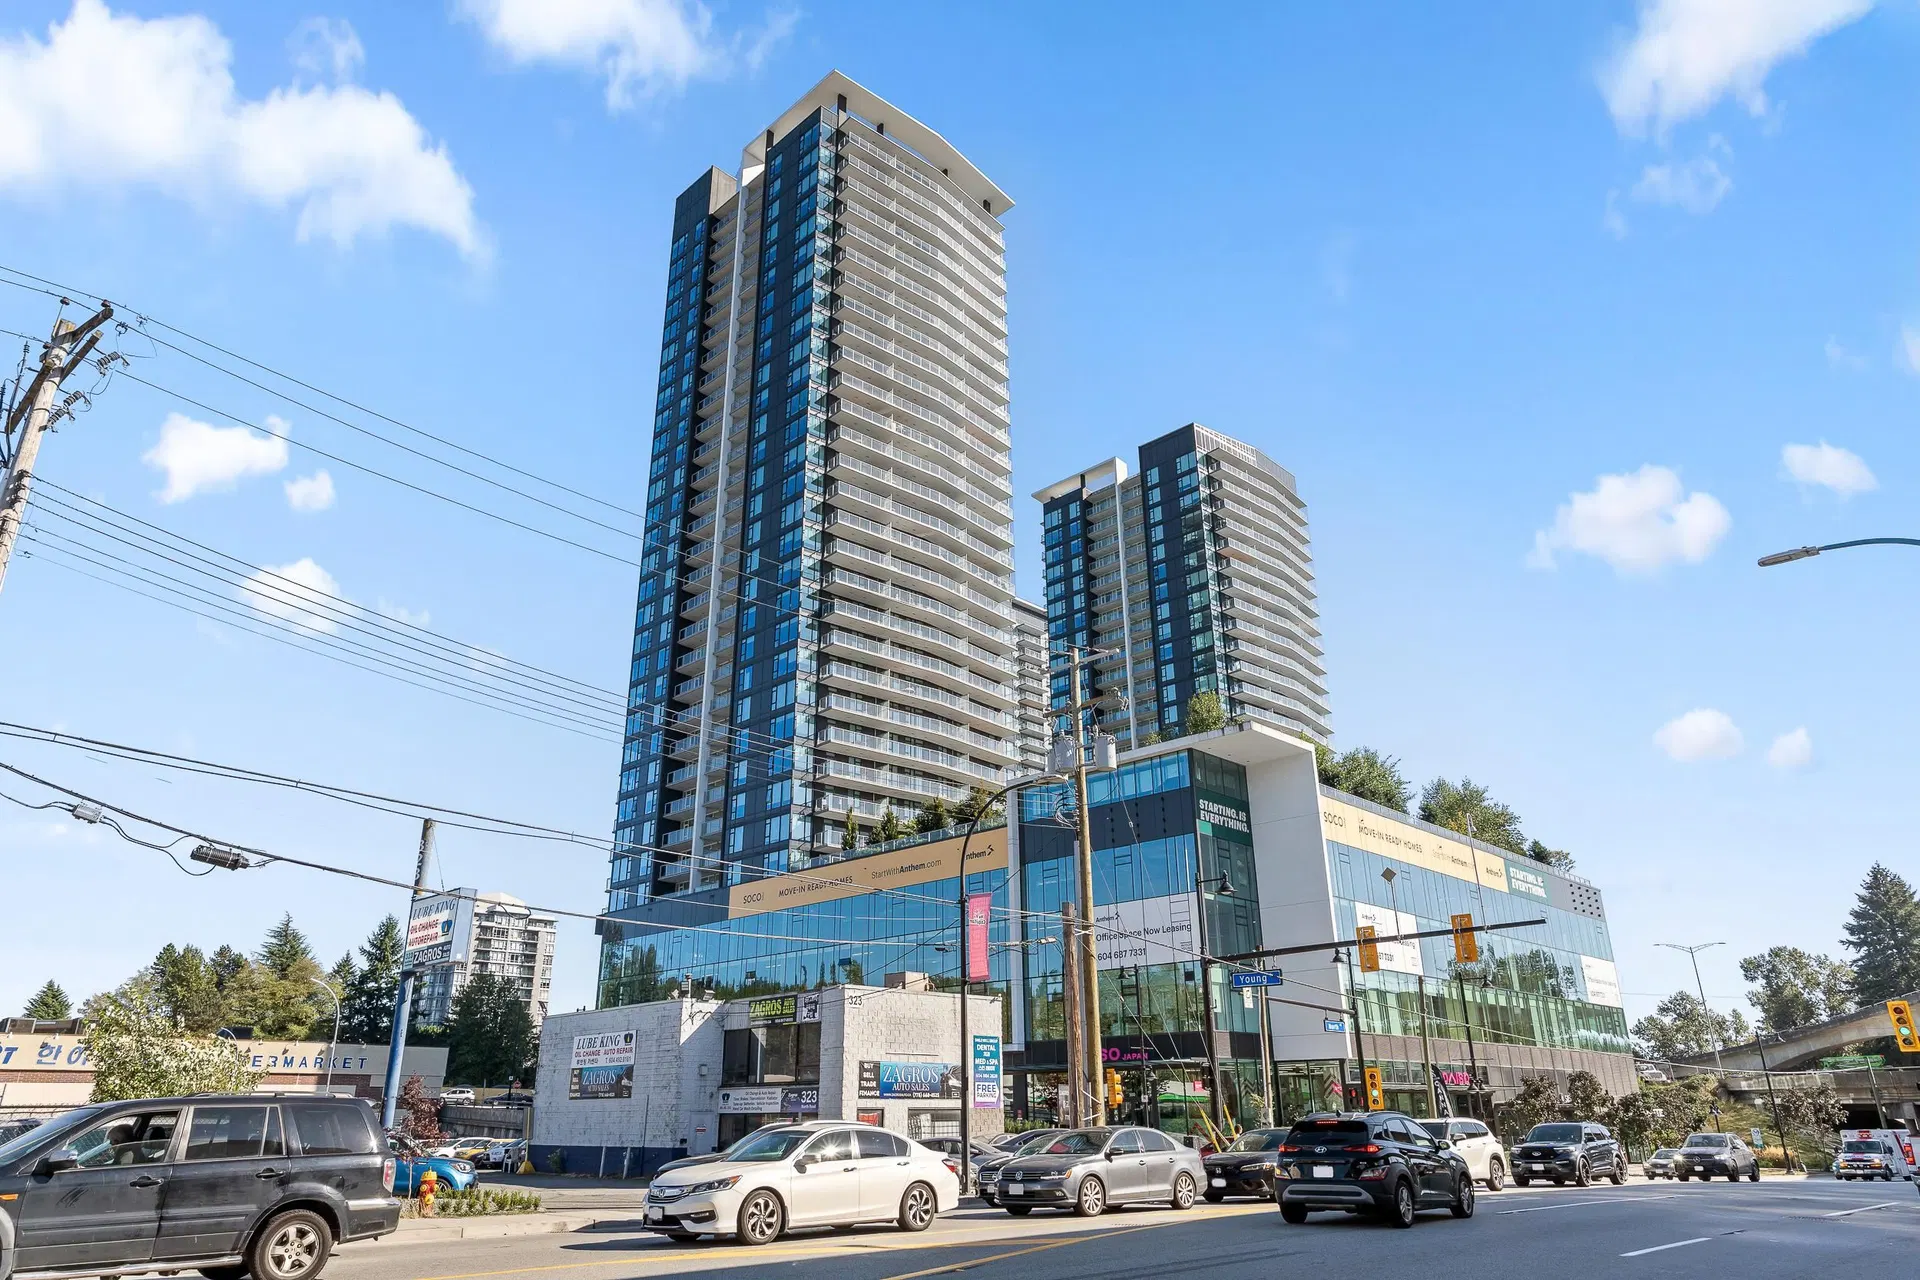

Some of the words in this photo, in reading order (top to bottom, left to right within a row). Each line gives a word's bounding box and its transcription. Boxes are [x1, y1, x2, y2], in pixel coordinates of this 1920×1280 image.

[1199, 799, 1238, 820] STARTING.
[1239, 811, 1246, 822] IS
[1200, 810, 1250, 833] EVERYTHING.
[1385, 833, 1402, 846] READY
[1403, 841, 1422, 854] HOMES
[778, 885, 806, 898] MOVE-IN
[872, 860, 942, 880] StartWithAnthem.com
[966, 850, 986, 860] nthem
[412, 906, 434, 921] LUBE
[434, 898, 456, 914] KING
[418, 919, 440, 932] CHANGE
[1096, 932, 1118, 942] Office
[1144, 926, 1160, 936] Now
[1162, 922, 1192, 934] Leasing
[414, 946, 442, 964] ZAGROS
[1098, 952, 1112, 961] 604
[1114, 950, 1128, 960] 687
[1129, 948, 1146, 957] 7331
[1240, 975, 1268, 984] Young
[750, 999, 782, 1018] ZAGROS
[848, 996, 863, 1006] 323
[576, 1037, 598, 1050] LUBE
[600, 1034, 620, 1048] KING
[582, 1070, 616, 1085] ZAGROS
[883, 1065, 939, 1083] ZAGROS
[801, 1090, 817, 1103] 323
[976, 1084, 996, 1092] FREE
